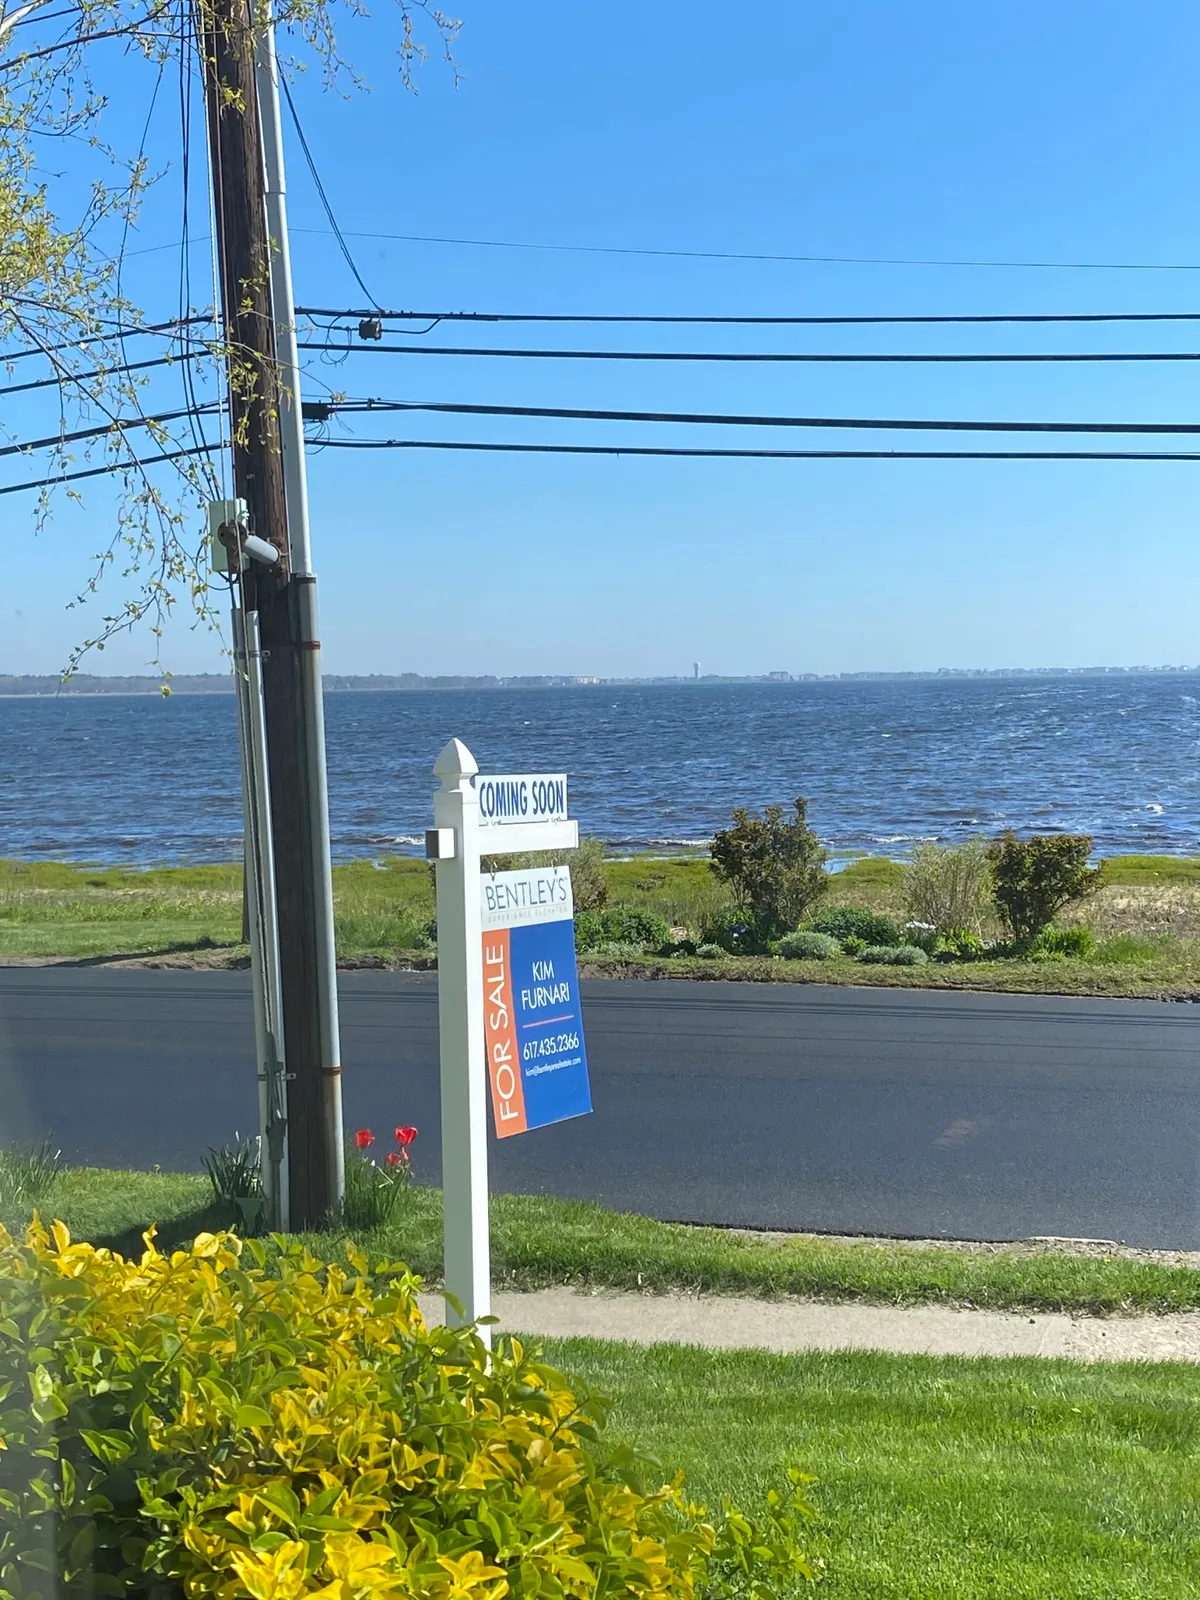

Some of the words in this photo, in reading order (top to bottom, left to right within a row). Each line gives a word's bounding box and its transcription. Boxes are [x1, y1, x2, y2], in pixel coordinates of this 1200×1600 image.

[480, 781, 528, 817] COMING
[532, 780, 564, 815] SOON
[485, 877, 567, 911] BENTLEY'S
[486, 944, 509, 1031] SALE
[532, 959, 555, 982] KIM
[521, 981, 570, 1011] FURNARI
[523, 1031, 580, 1061] 617.435.2366
[494, 1038, 519, 1121] FOR
